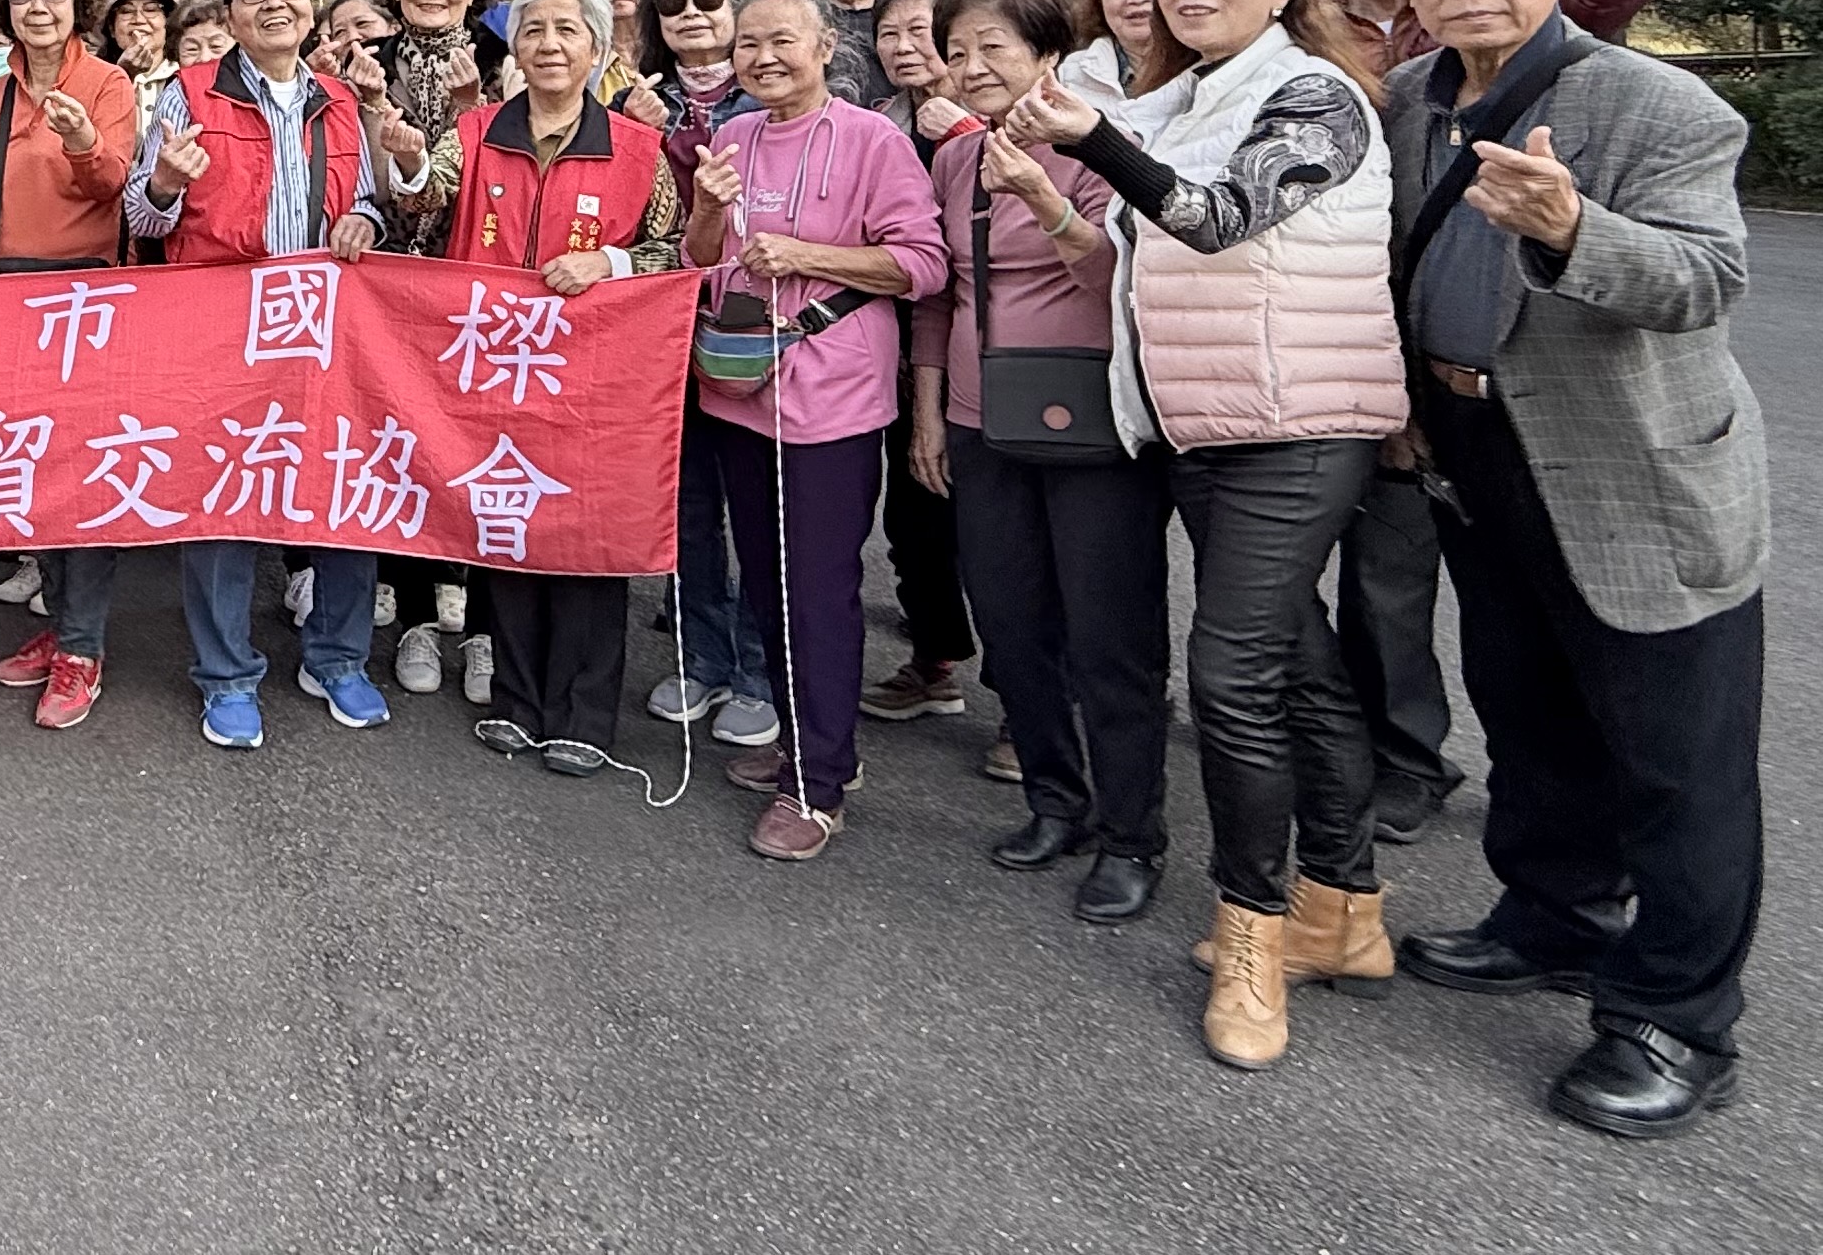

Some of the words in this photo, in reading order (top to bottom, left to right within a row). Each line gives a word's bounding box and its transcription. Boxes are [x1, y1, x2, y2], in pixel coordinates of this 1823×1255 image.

[481, 213, 498, 247] 監事
[568, 218, 583, 253] 文教
[585, 221, 600, 249] 台北
